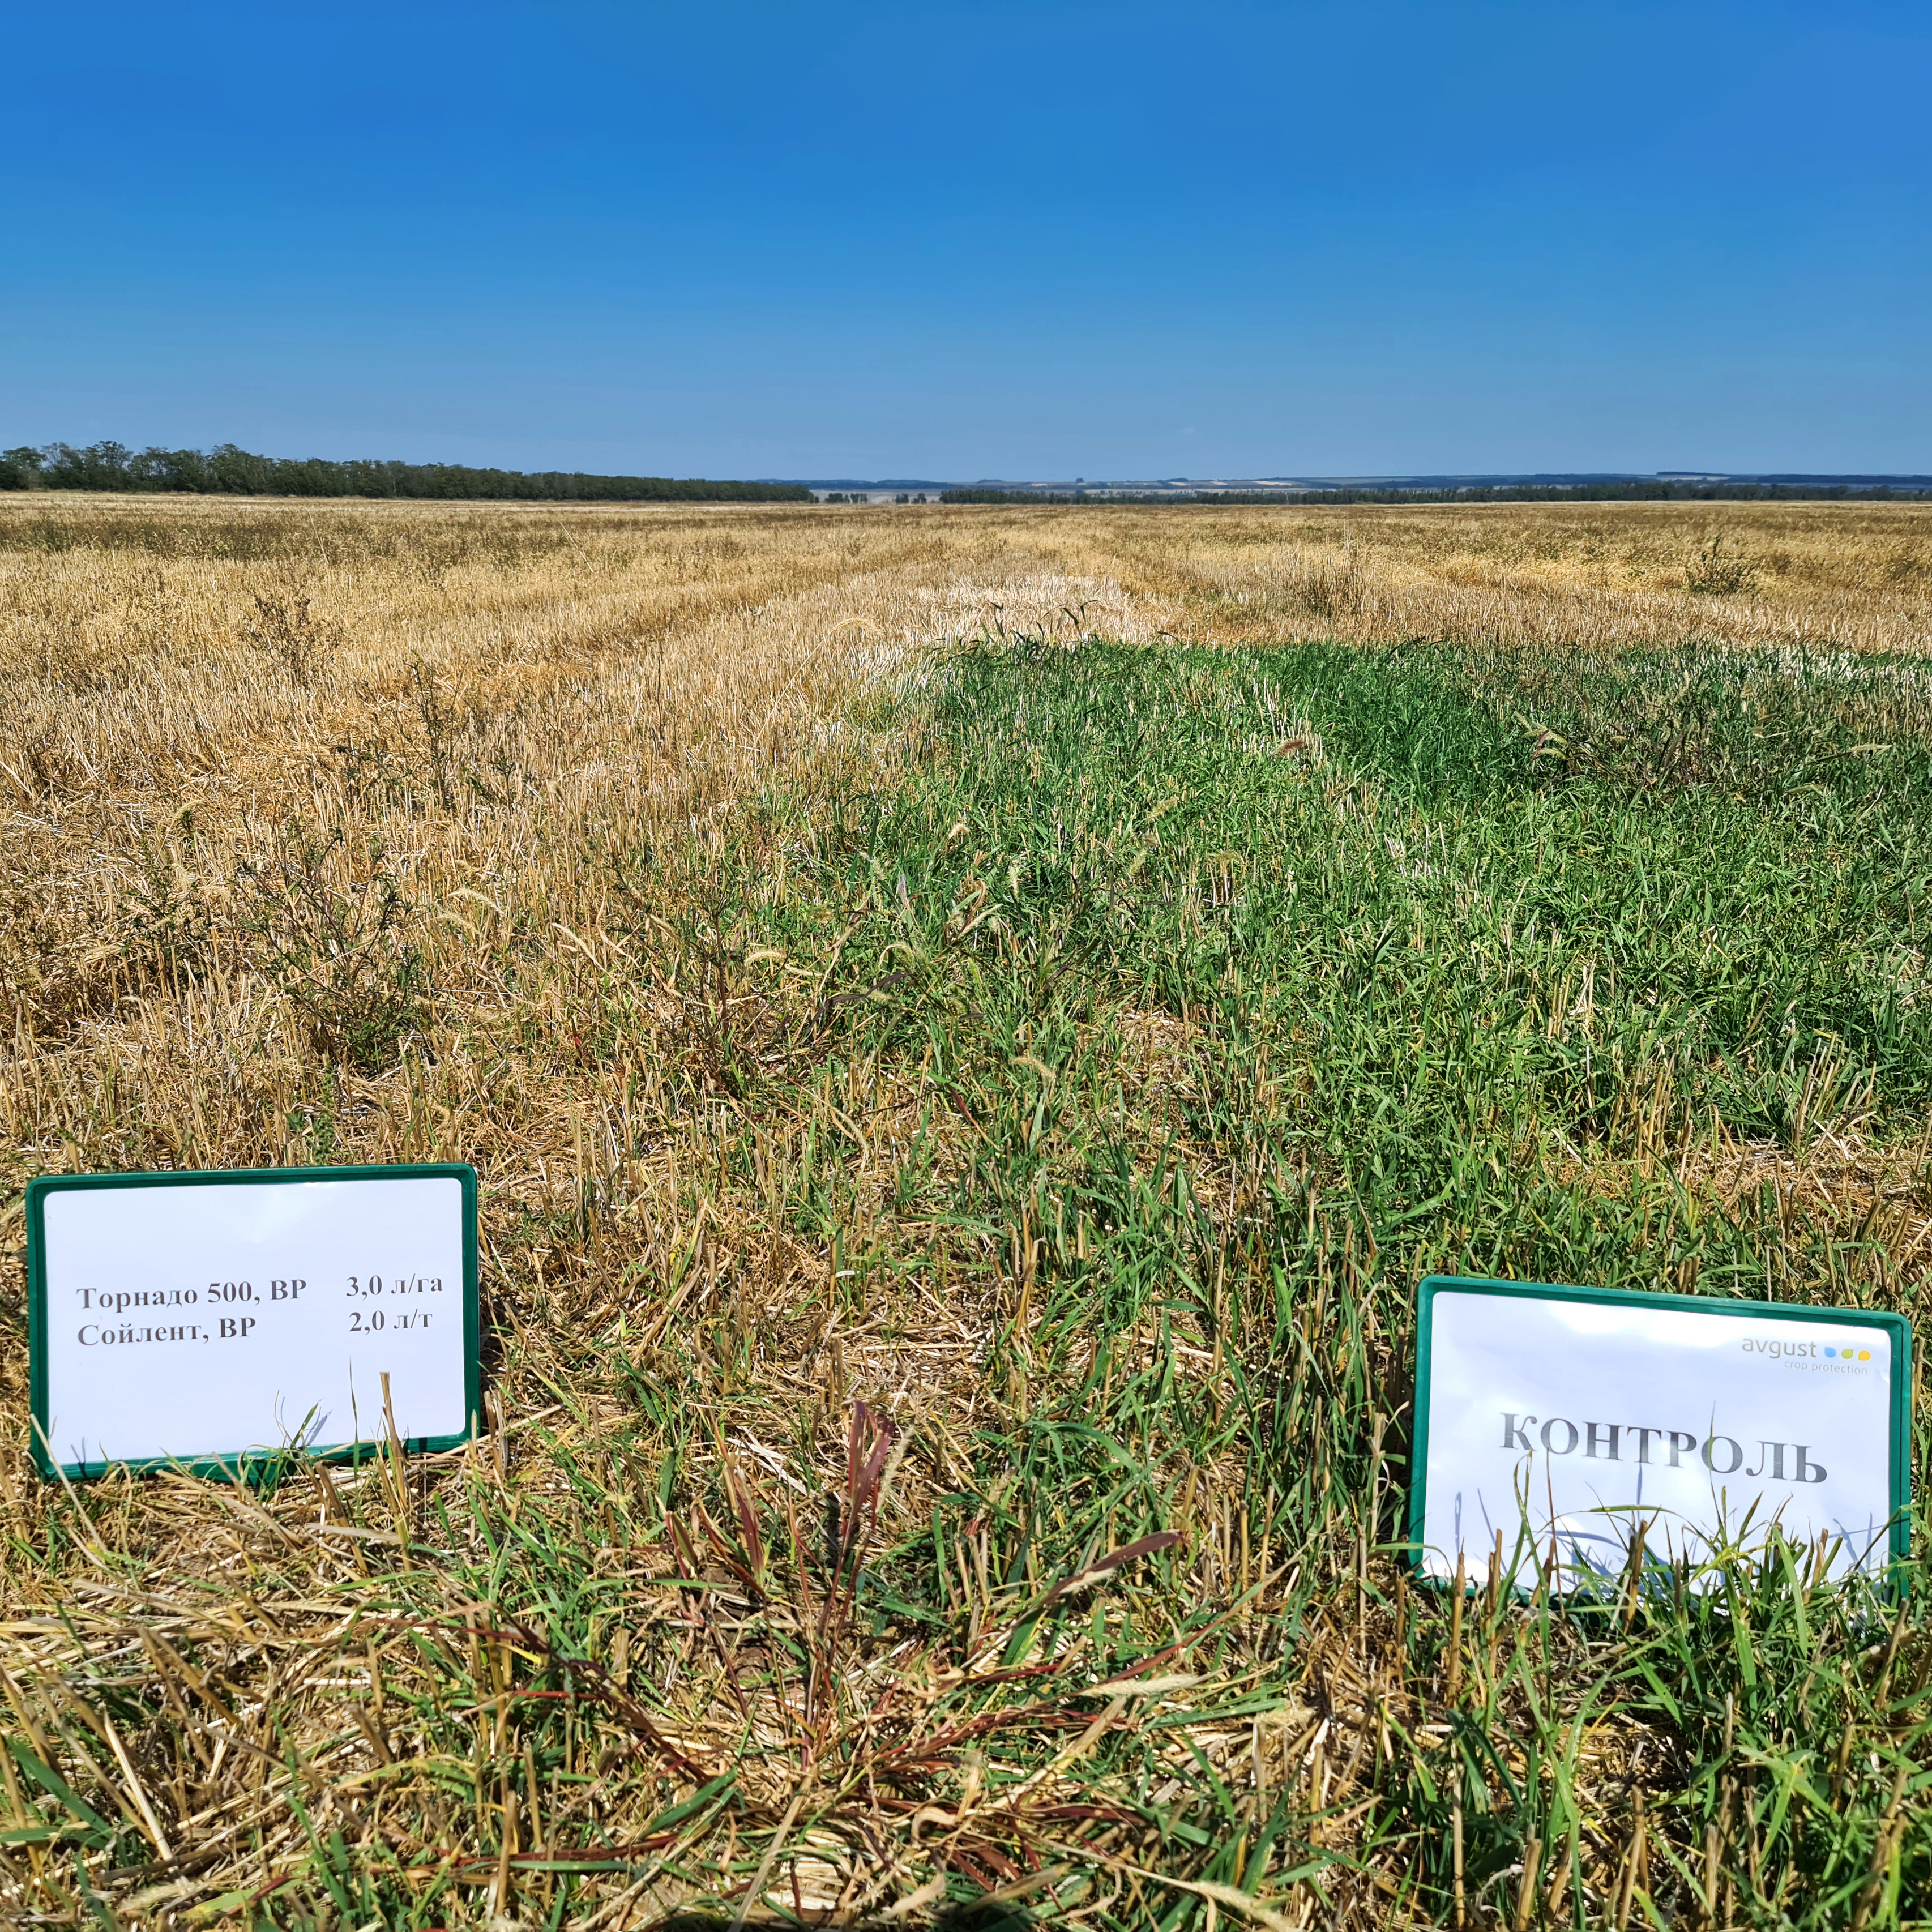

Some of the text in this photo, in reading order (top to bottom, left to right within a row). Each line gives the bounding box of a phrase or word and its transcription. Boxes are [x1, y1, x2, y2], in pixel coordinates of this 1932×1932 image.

[76, 1273, 443, 1313] Торнадо 500, ВР 3,0 л/га
[77, 1309, 433, 1347] Сойлент, ВР 2,0 л/т
[1742, 1338, 1816, 1359] avgust
[1784, 1361, 1867, 1375] crop protection
[1500, 1412, 1828, 1484] КОНТРОЛЬ
